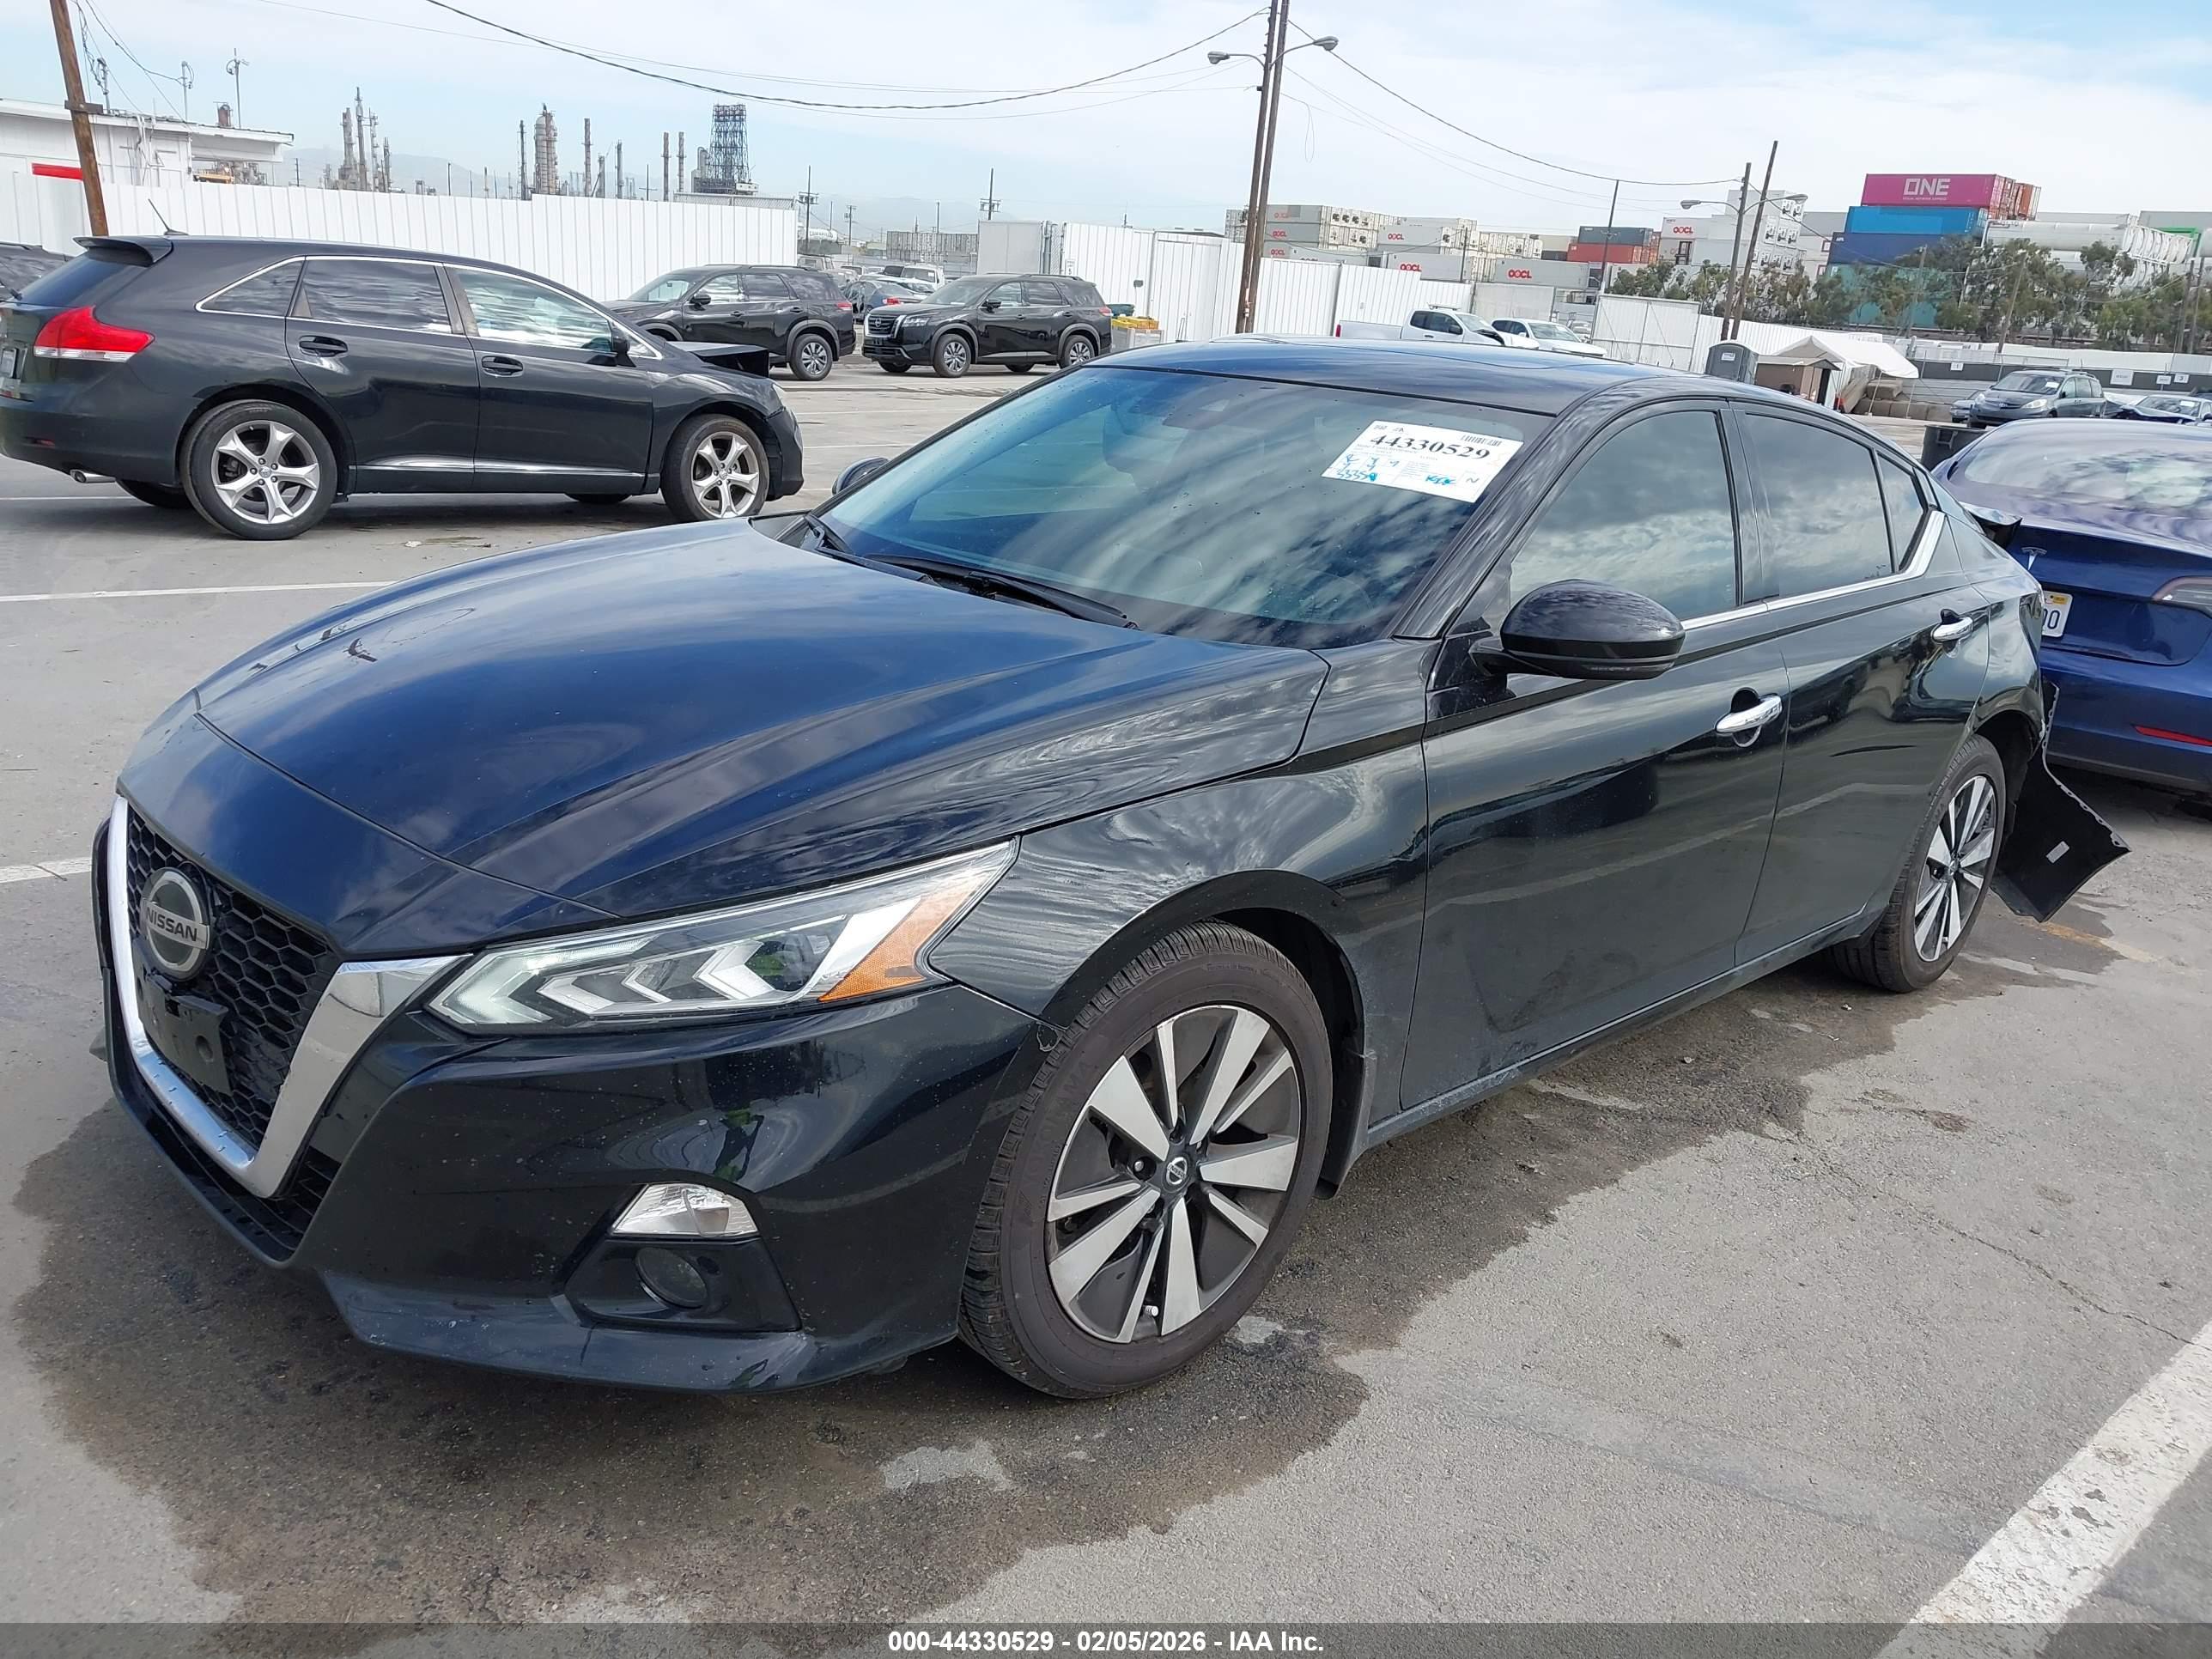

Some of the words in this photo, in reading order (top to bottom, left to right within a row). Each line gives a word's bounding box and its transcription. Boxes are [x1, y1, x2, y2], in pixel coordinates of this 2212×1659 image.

[1903, 178, 1951, 196] ONE
[1508, 269, 1532, 279] OOCL
[1370, 434, 1490, 459] 44330529
[146, 906, 198, 942] NISSAN
